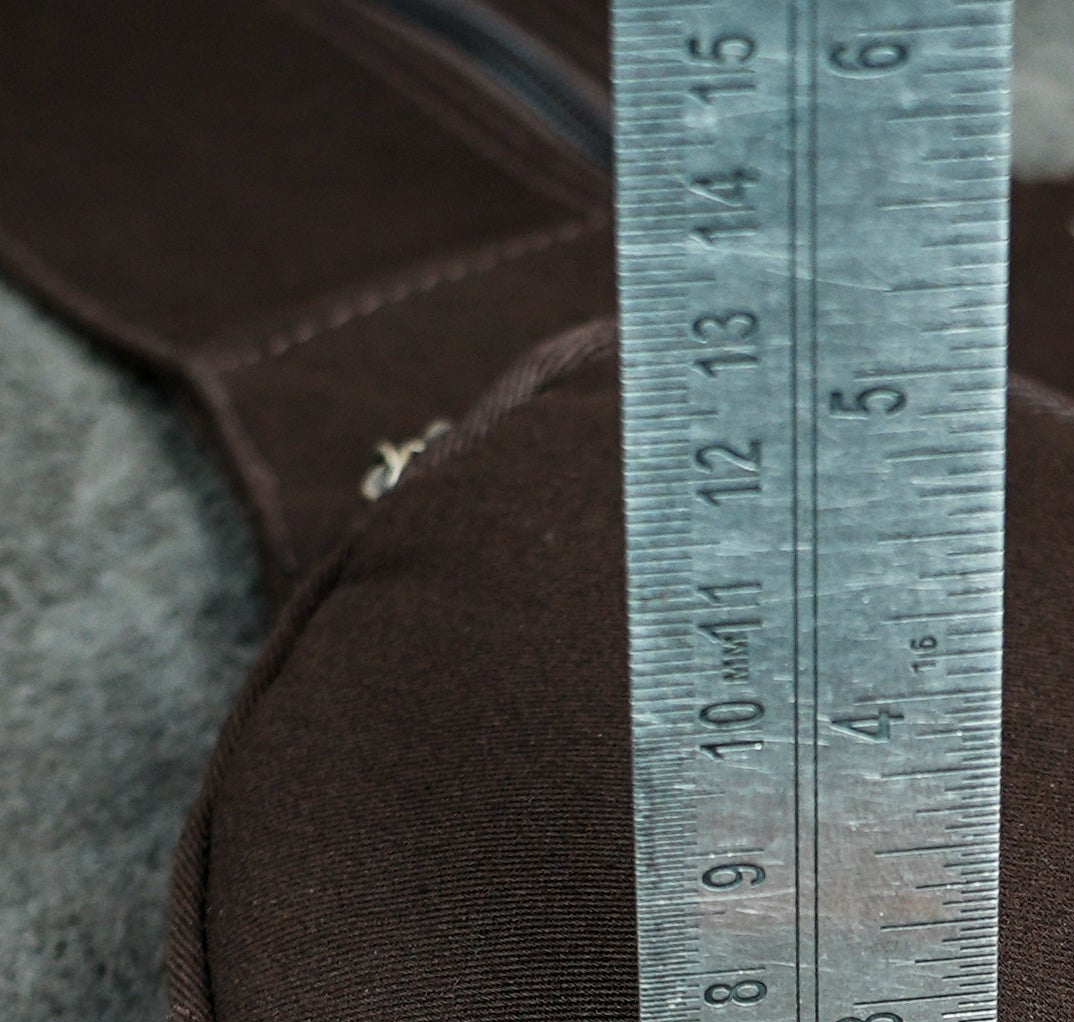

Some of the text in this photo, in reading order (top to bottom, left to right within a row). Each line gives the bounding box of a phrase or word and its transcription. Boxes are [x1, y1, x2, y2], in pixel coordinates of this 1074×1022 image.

[683, 33, 757, 103] 15
[827, 40, 909, 78] 6
[687, 167, 758, 244] 14
[689, 311, 758, 377] 13
[827, 387, 907, 420] 5
[694, 439, 762, 506] 12
[696, 582, 762, 643] 11
[910, 634, 938, 674] 16
[700, 701, 765, 760] 10
[830, 709, 904, 744] 4
[702, 863, 766, 892] 9
[704, 979, 767, 1006] 8
